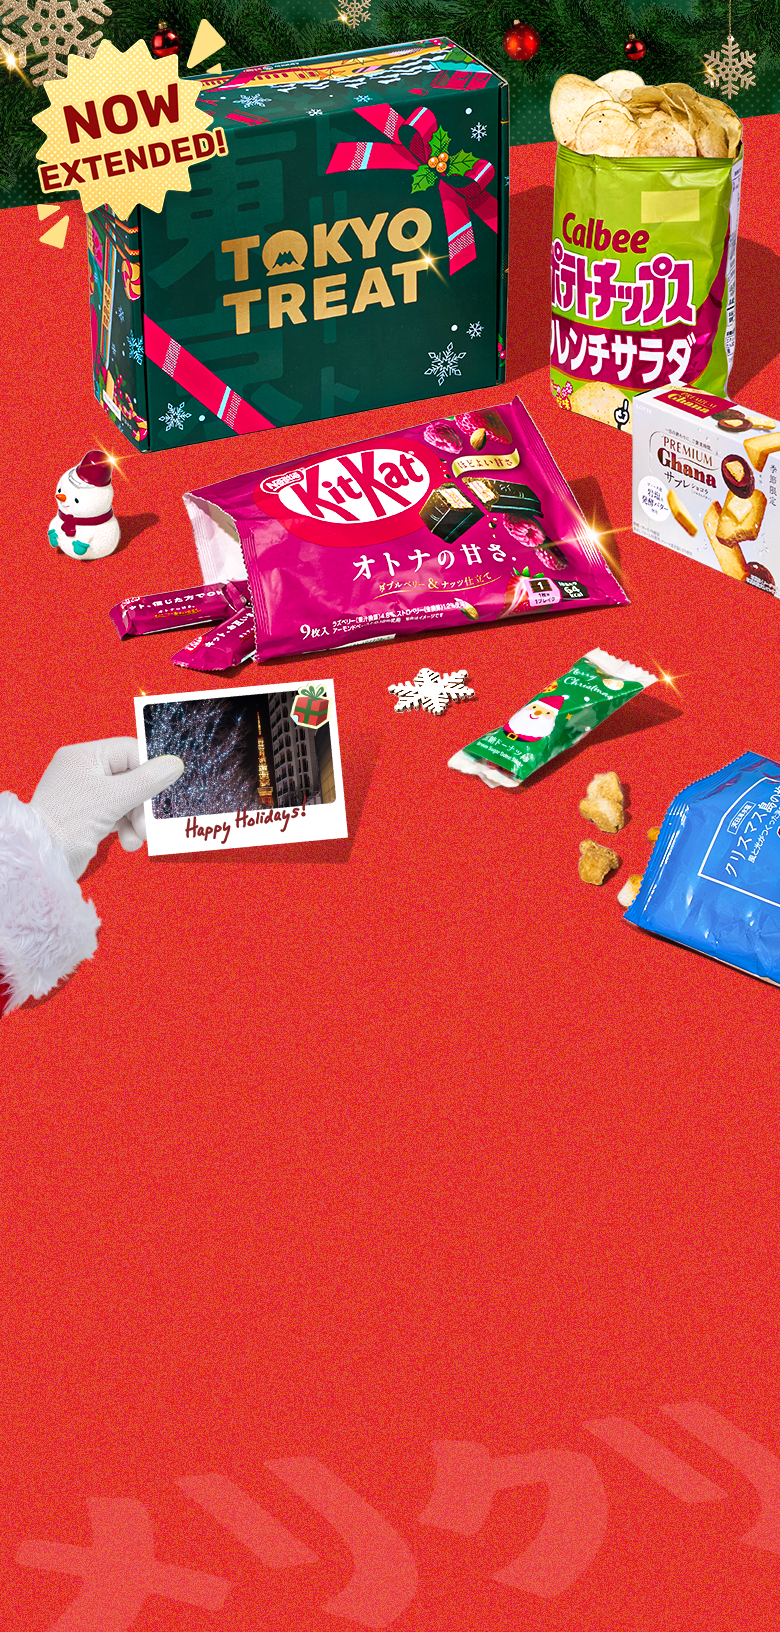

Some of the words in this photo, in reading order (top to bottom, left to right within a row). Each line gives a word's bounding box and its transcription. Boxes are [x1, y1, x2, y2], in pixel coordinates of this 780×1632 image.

[221, 207, 433, 282] TOKYO
[562, 212, 650, 255] Calbee
[222, 260, 430, 335] TREAT
[667, 393, 710, 414] Ghana
[656, 447, 717, 489] Ghana
[663, 436, 713, 467] PREMIUM
[289, 451, 424, 521] KitKat
[299, 623, 330, 641] 9枚入
[563, 676, 614, 701] Christmas
[185, 816, 231, 844] Happy
[235, 795, 306, 832] Holidays!
